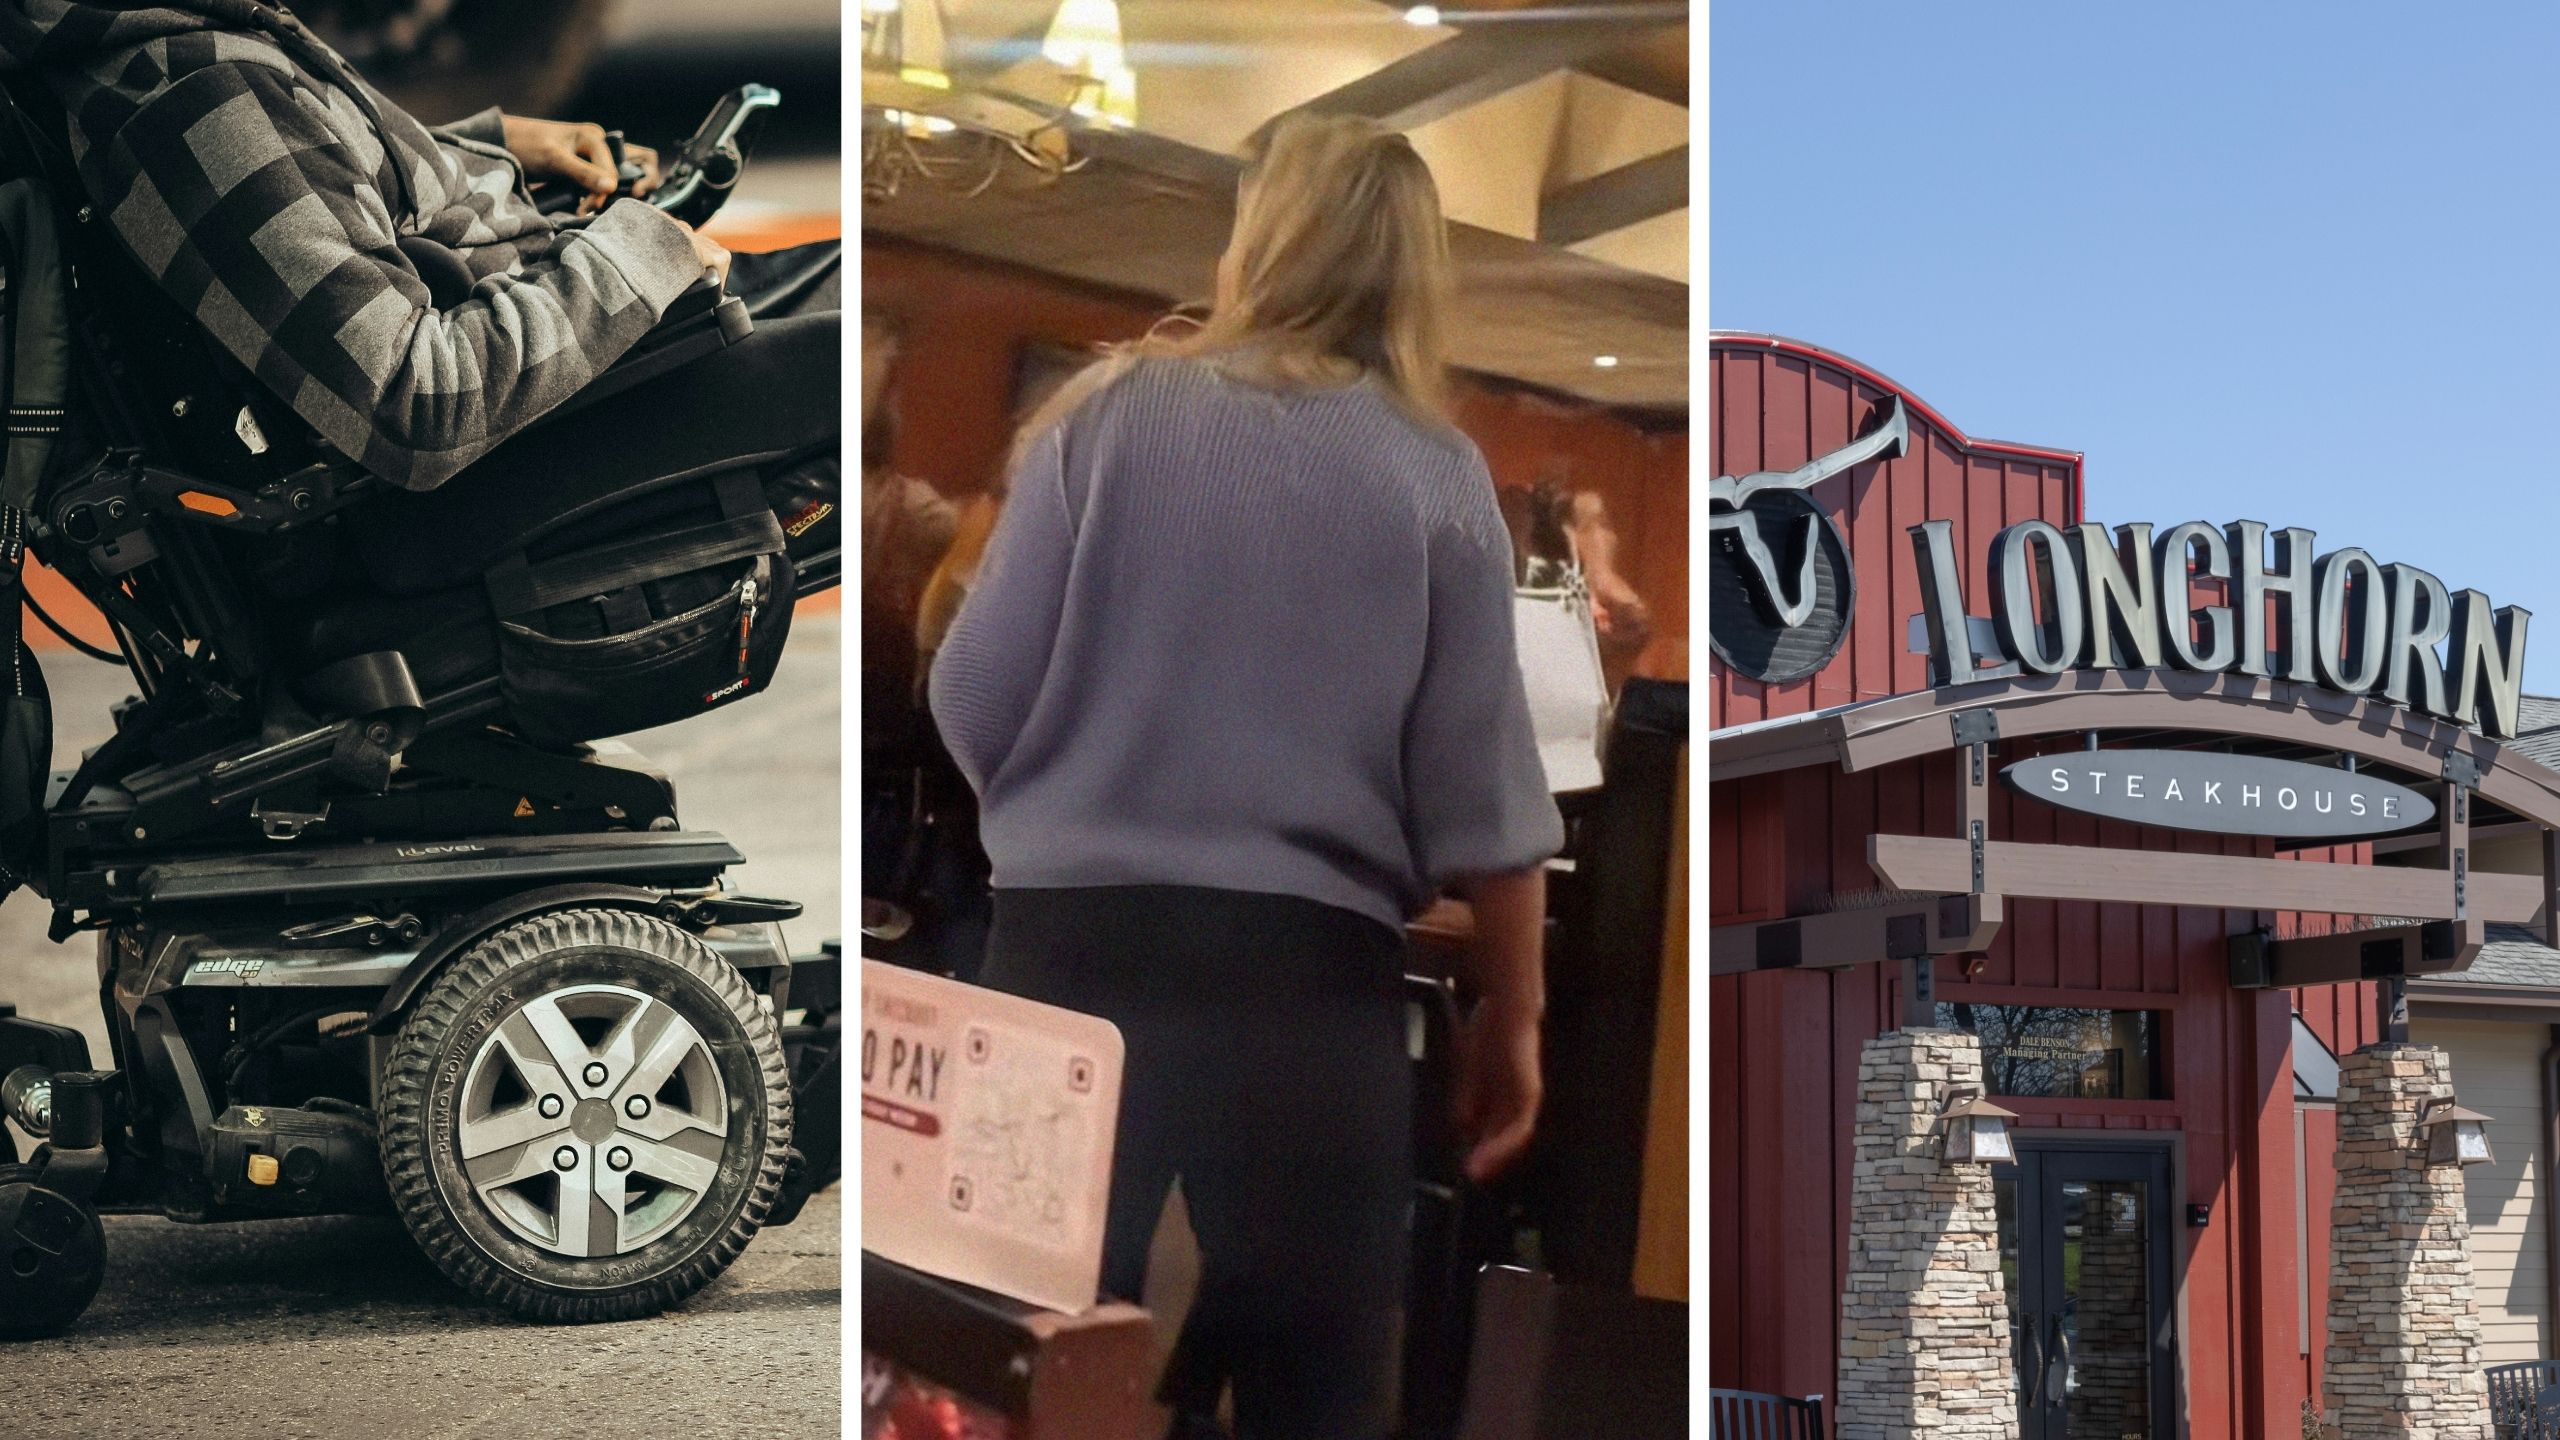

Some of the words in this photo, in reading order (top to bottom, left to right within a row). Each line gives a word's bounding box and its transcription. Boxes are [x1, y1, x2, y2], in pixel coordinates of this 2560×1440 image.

[1906, 518, 2532, 740] LONGHORN
[2051, 768, 2400, 818] STEAKHOUSE
[194, 957, 264, 977] edge
[2003, 1047, 2048, 1060] Managing
[2052, 1050, 2086, 1060] Partner
[2020, 1036, 2039, 1047] DALE
[2041, 1037, 2070, 1048] BENSON
[889, 1037, 945, 1101] PAY
